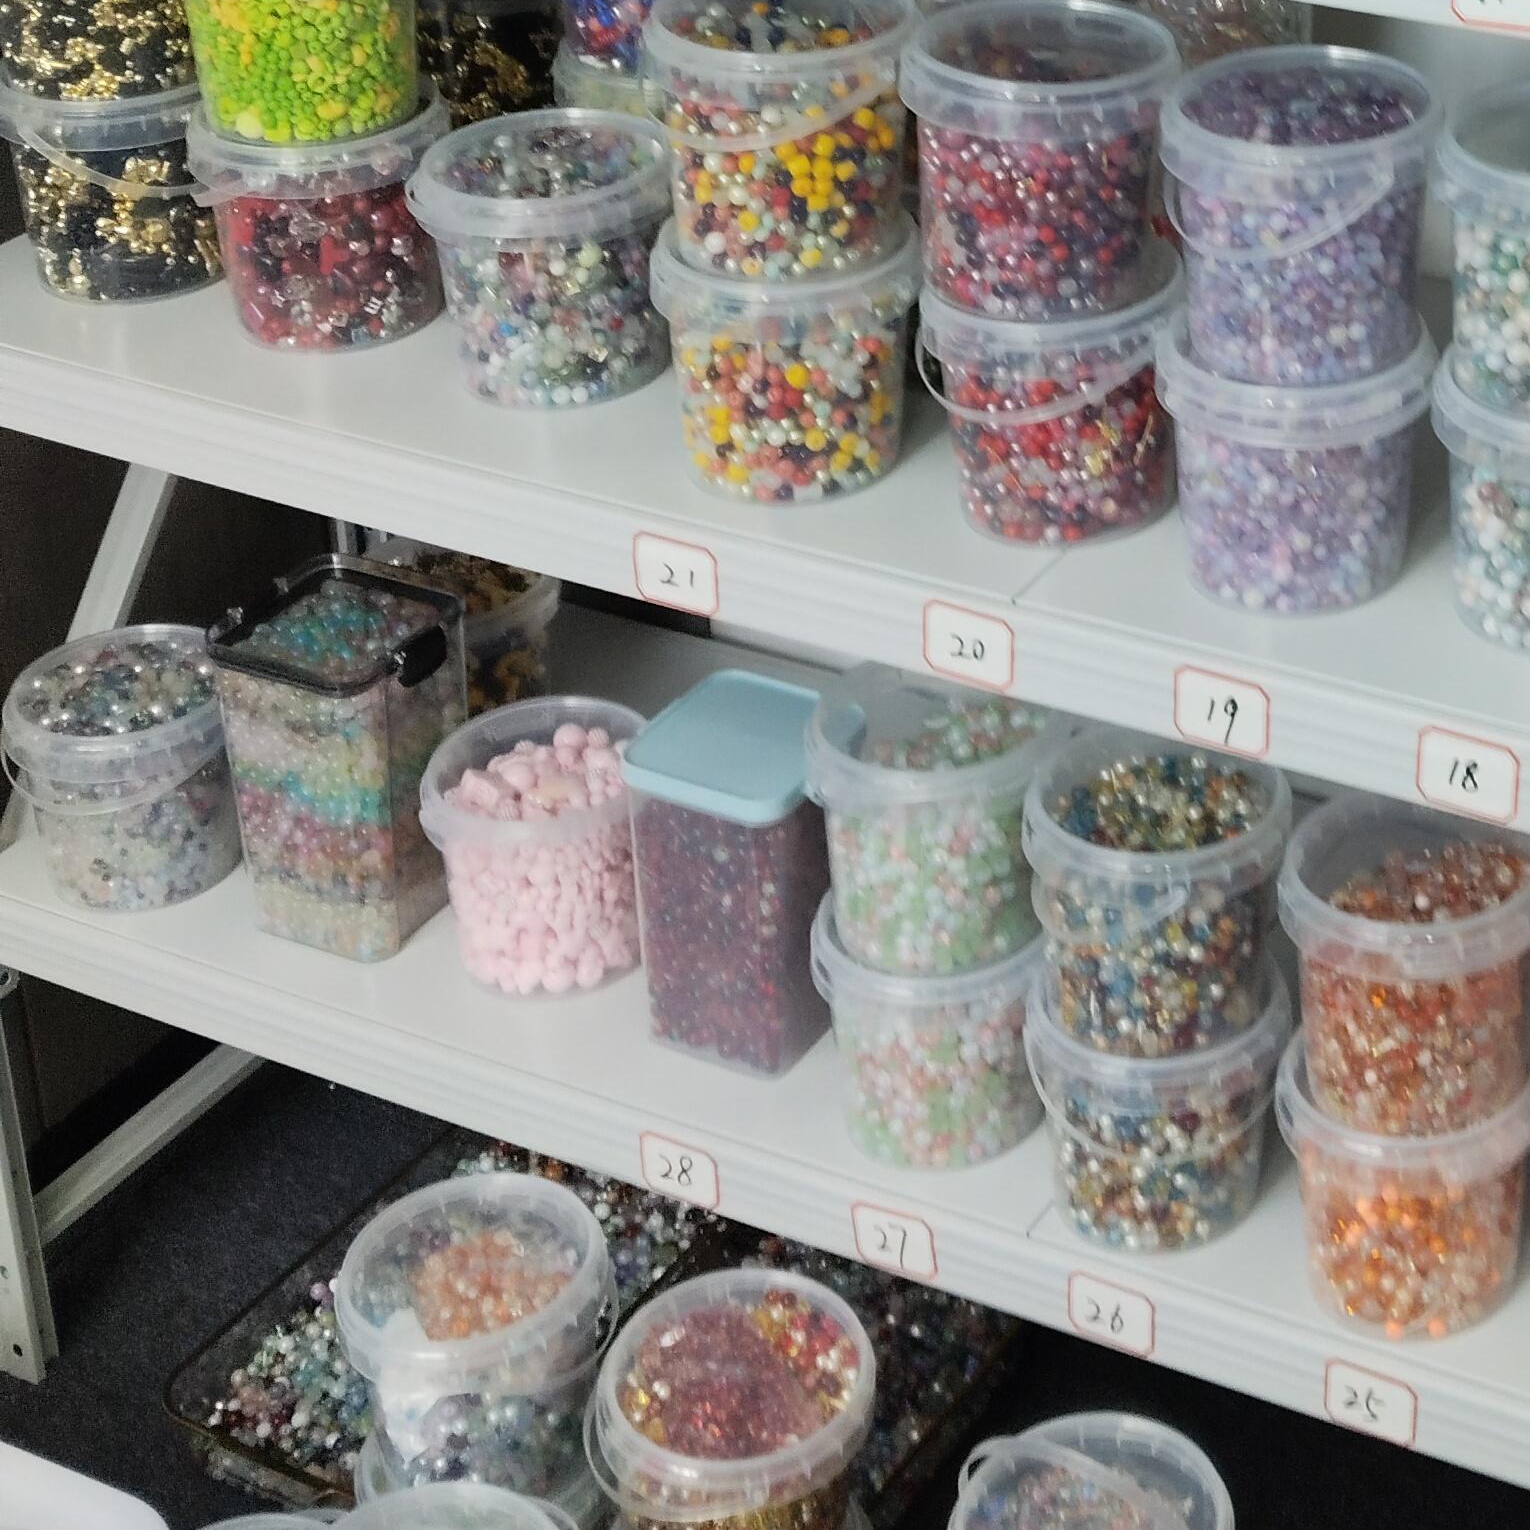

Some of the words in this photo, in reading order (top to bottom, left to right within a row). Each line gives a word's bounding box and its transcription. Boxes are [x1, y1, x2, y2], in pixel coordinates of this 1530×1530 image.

[659, 563, 694, 587] 21
[950, 632, 986, 661] 20
[1207, 696, 1239, 746] 19
[1449, 758, 1479, 792] 18
[658, 1154, 693, 1186] 28
[873, 1223, 907, 1269] 27
[1085, 1297, 1124, 1334] 26
